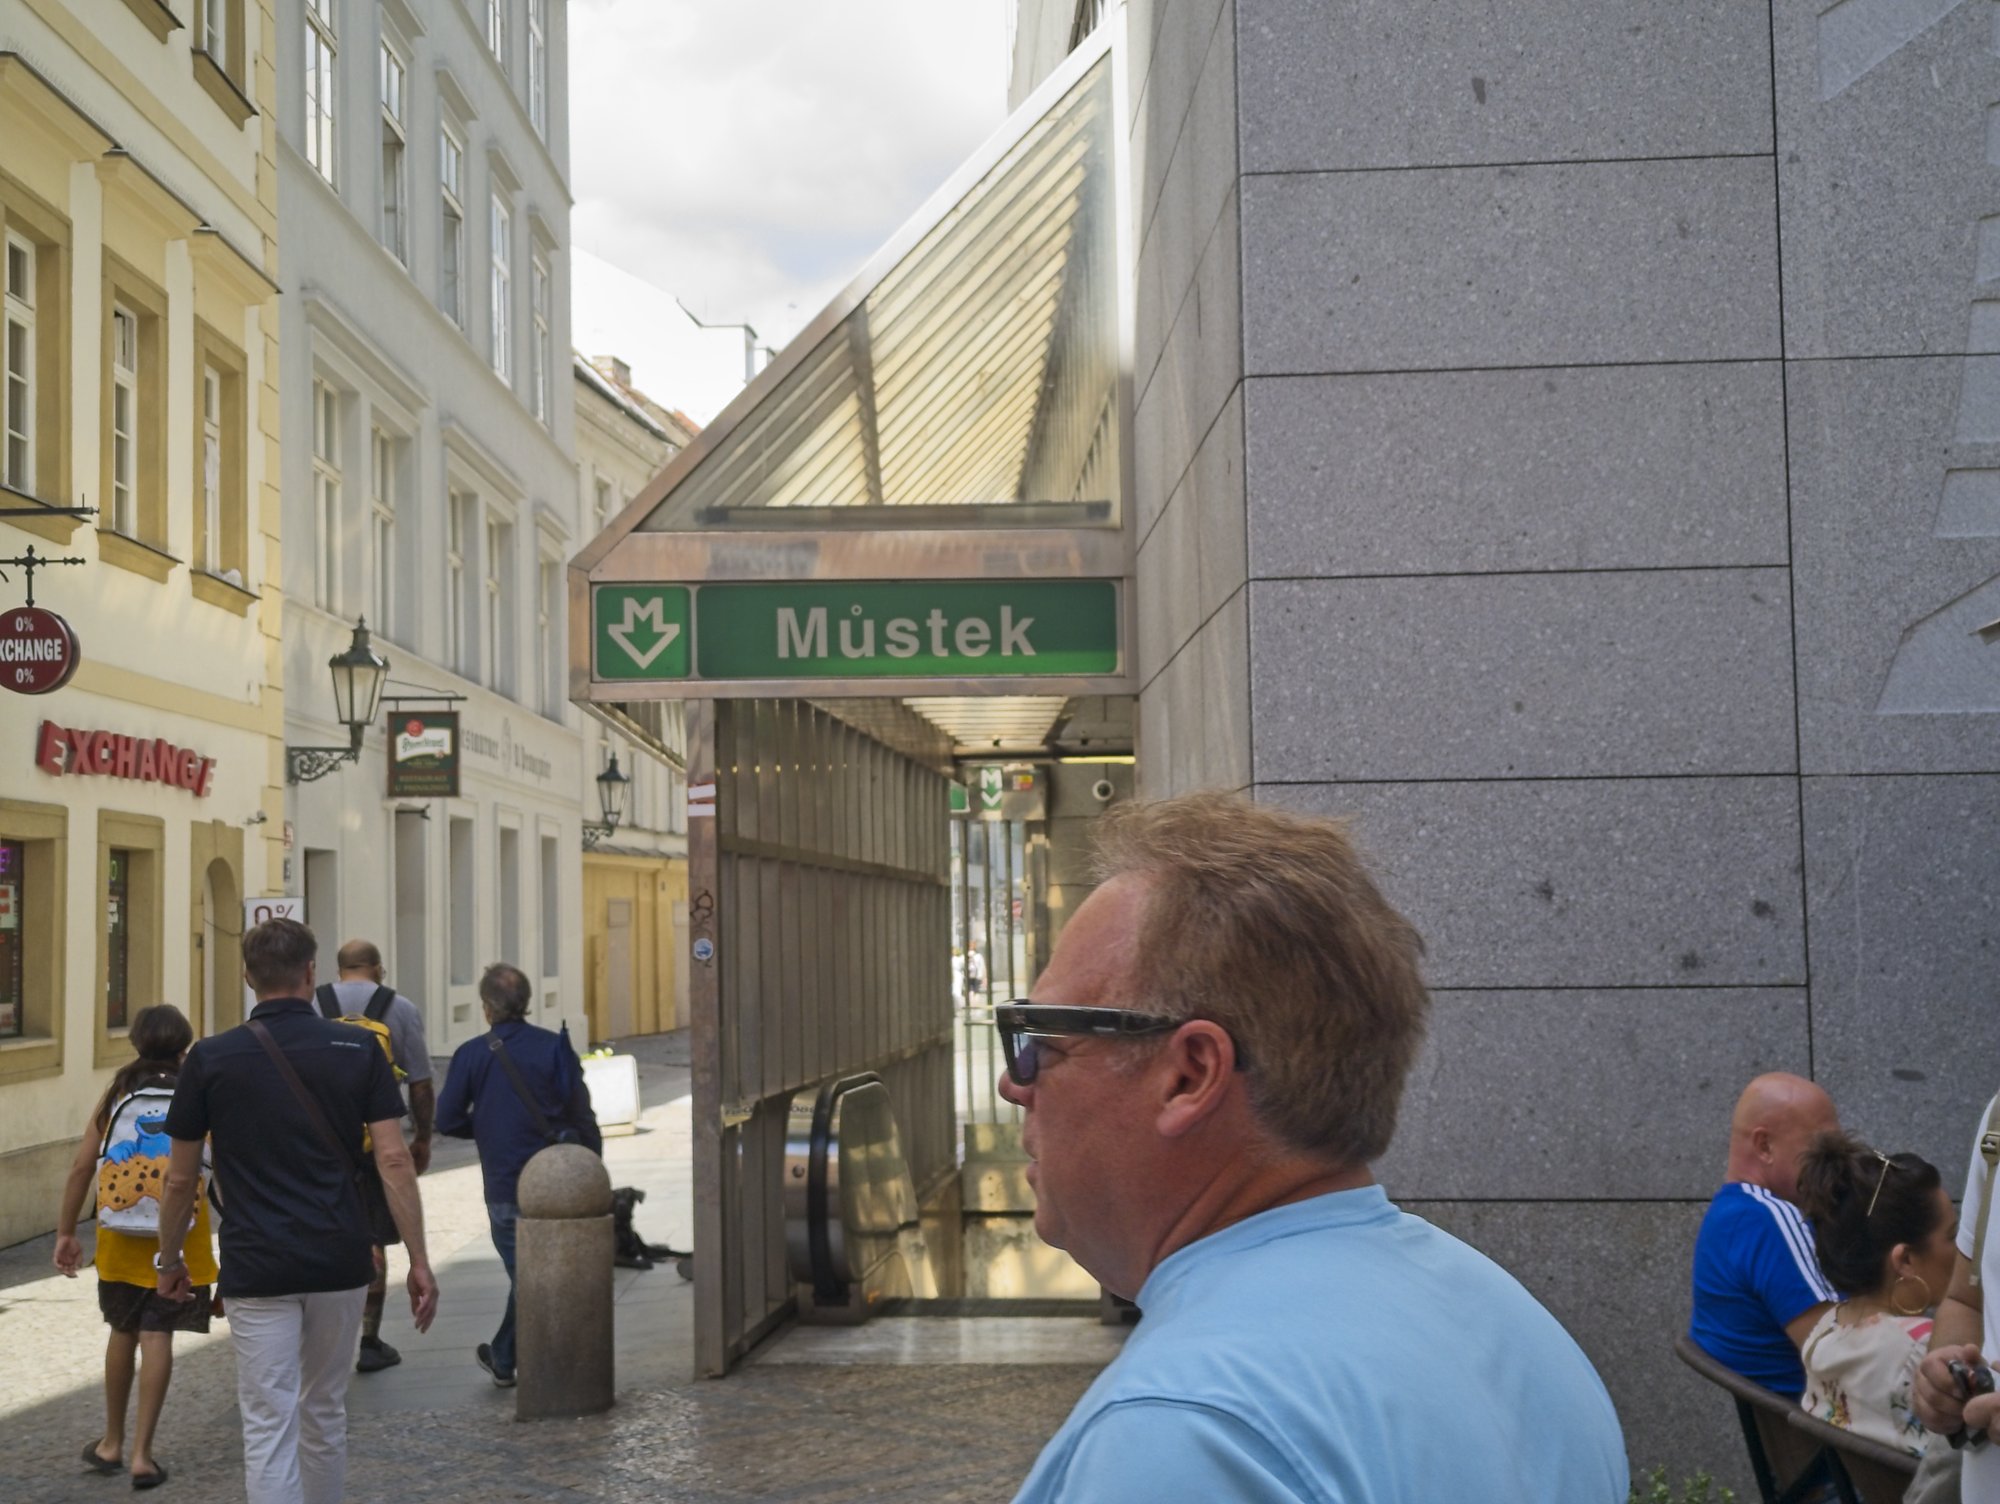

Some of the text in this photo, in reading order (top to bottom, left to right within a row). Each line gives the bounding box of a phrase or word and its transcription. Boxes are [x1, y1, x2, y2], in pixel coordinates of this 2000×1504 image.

[16, 616, 34, 632] 0%
[777, 604, 1037, 659] Můstek
[16, 668, 34, 683] 0%
[36, 719, 217, 798] EXCHANGE
